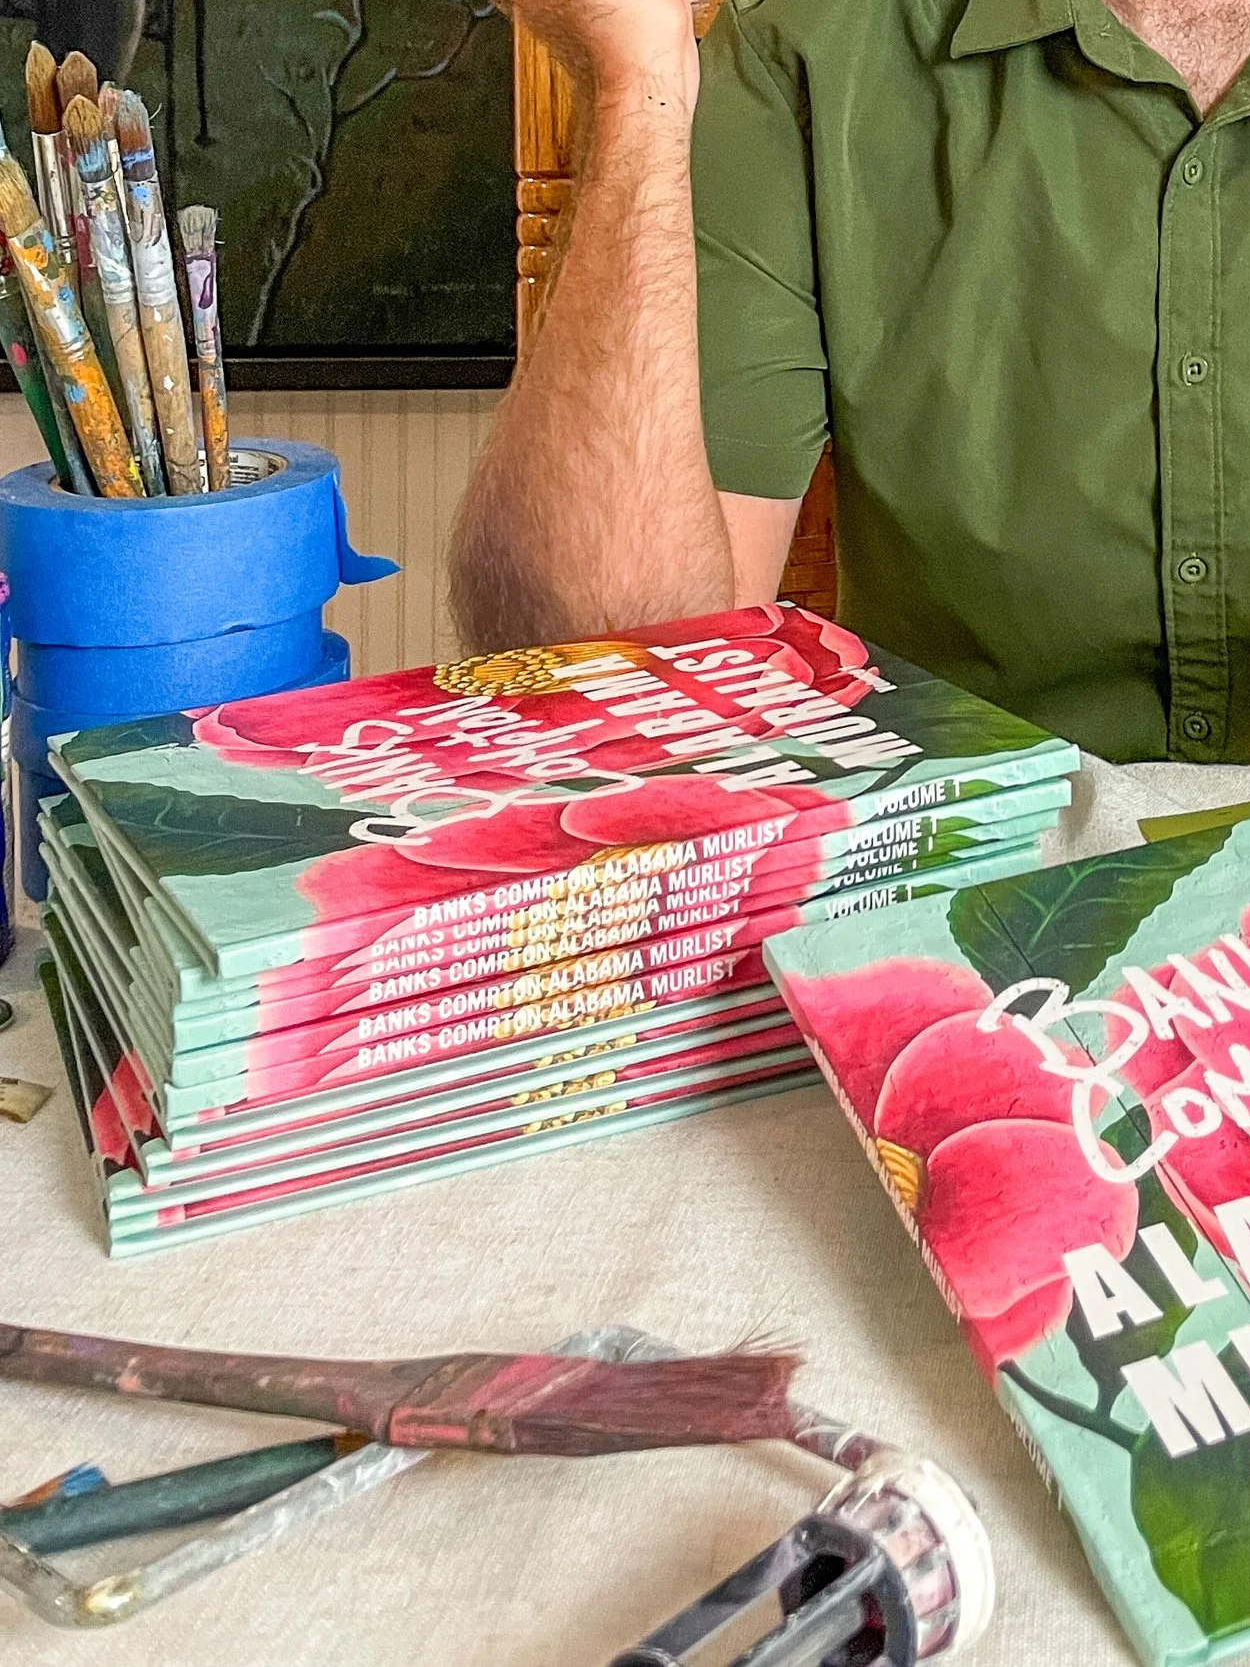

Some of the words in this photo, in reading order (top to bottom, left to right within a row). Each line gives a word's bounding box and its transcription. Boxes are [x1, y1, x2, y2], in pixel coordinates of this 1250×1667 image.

[551, 653, 816, 792] ALABAMA
[648, 638, 923, 768] MURALIST
[413, 892, 486, 929] BANKS
[493, 866, 597, 909] COMPTON
[602, 841, 697, 884] ALABAMA
[703, 820, 786, 858] MURLIST
[875, 781, 946, 816] VOLUME
[953, 779, 960, 797] 1
[564, 877, 662, 913] ALABAMA
[668, 853, 755, 890] MURLIST
[848, 818, 922, 852] VOLUME
[930, 816, 937, 834] 1
[846, 841, 918, 869] VOLUME
[358, 1004, 431, 1039] BANKS
[438, 974, 544, 1018] COMPTON
[548, 950, 643, 990] ALABAMA
[650, 928, 734, 966] MURLIST
[824, 885, 898, 921] VOLUME
[358, 1033, 431, 1068] BANKS
[438, 1005, 544, 1049] COMPTON
[548, 981, 645, 1021] ALABAMA
[651, 958, 735, 997] MURLIST
[369, 968, 441, 1002] BANKS
[449, 944, 552, 982] COMPTON
[557, 918, 651, 961] ALABAMA
